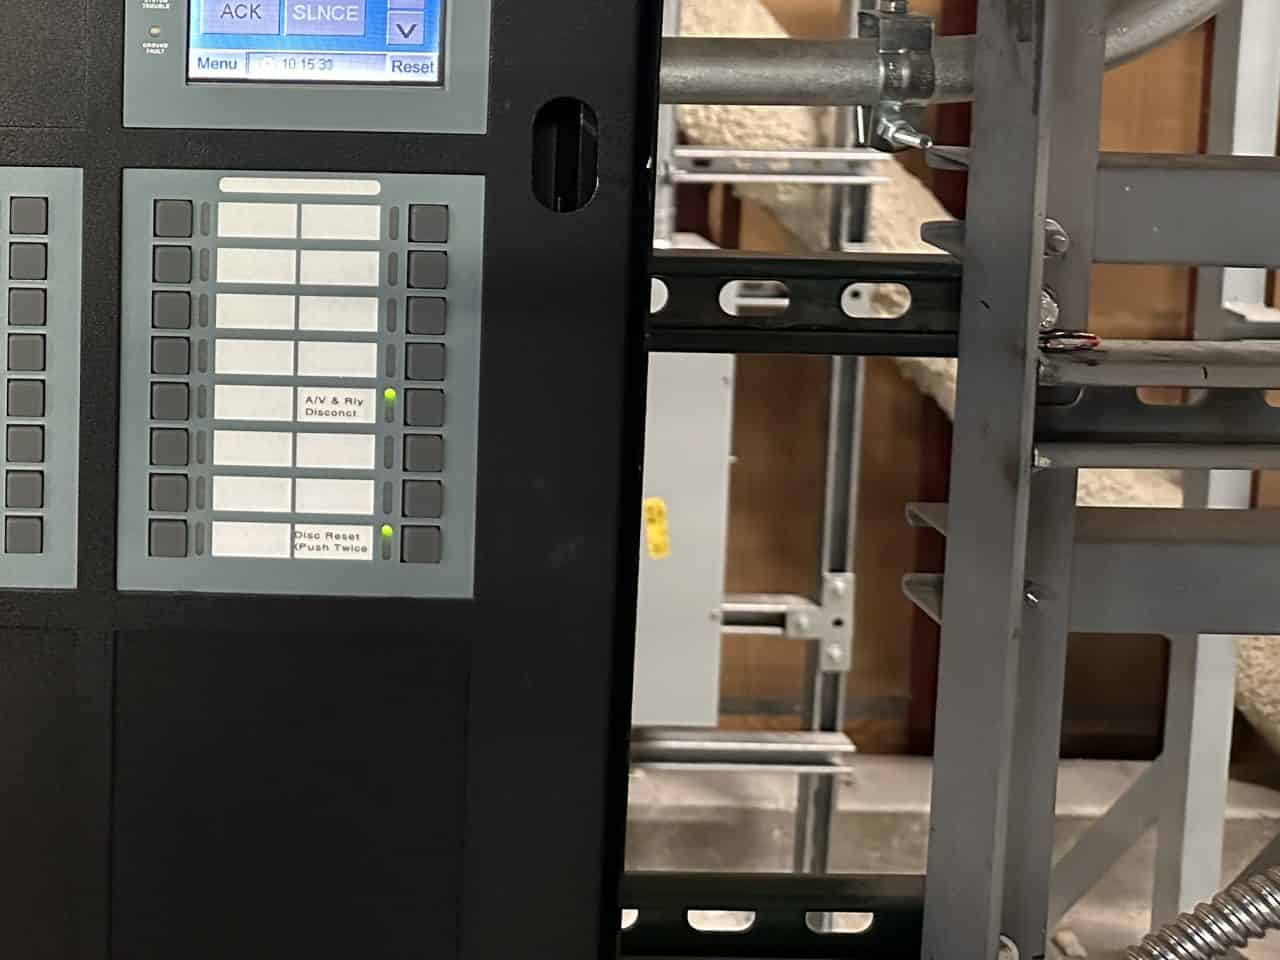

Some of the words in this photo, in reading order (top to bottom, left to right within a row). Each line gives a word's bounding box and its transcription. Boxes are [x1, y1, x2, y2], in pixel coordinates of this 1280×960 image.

[219, 3, 262, 19] ACK
[292, 5, 359, 22] SLNCE
[197, 56, 238, 70] Menu
[391, 59, 434, 74] Reset
[305, 396, 326, 405] A/V
[331, 396, 339, 405] &
[305, 407, 357, 416] Disconct
[294, 530, 320, 539] Disc
[325, 531, 360, 540] Reset
[333, 543, 368, 553] Twice
